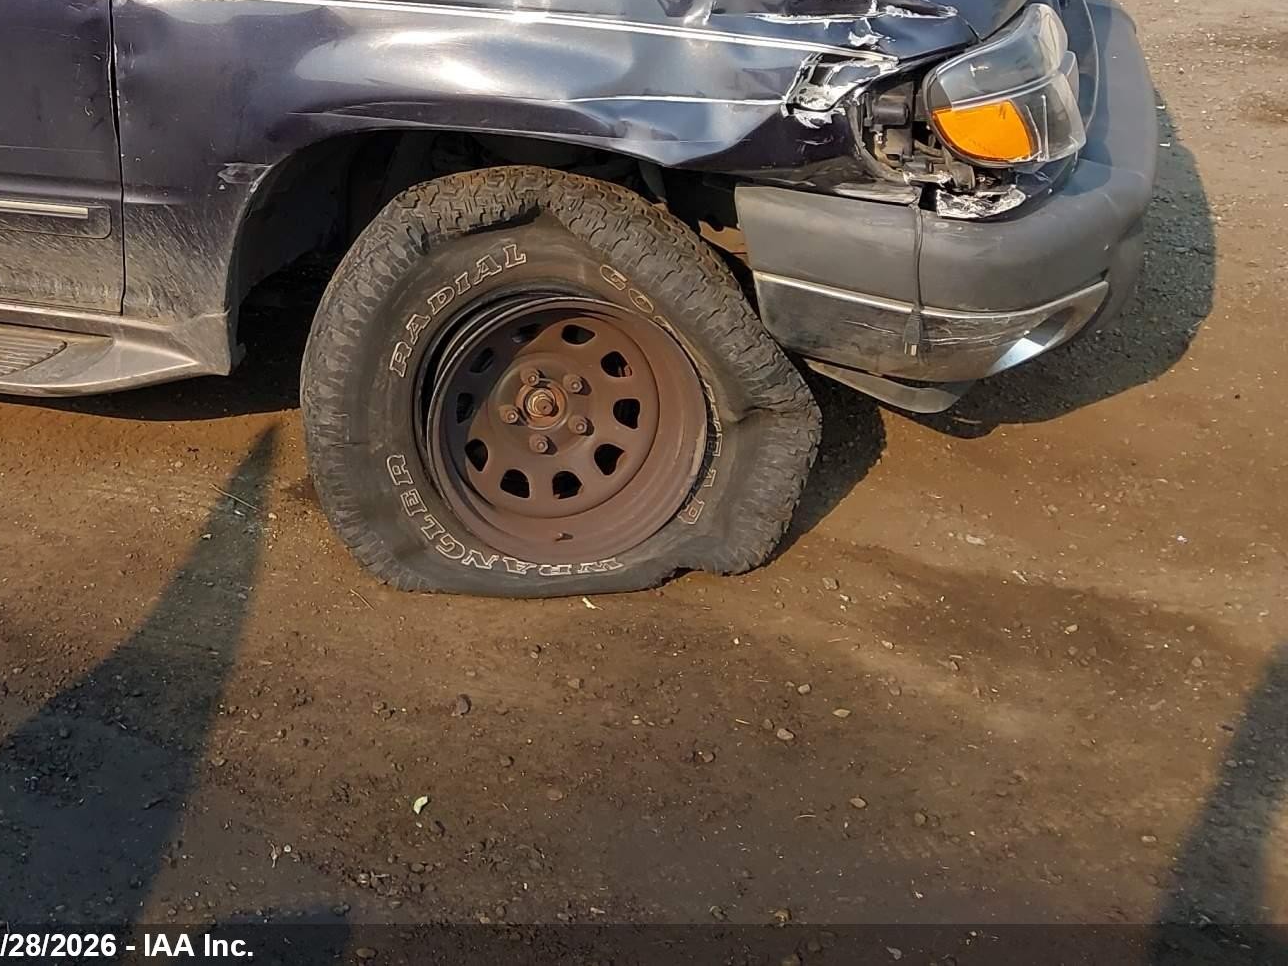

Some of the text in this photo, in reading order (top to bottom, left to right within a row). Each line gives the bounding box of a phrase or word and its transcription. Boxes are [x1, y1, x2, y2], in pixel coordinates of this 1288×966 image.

[389, 243, 527, 378] RADIAL
[600, 263, 723, 526] GOEAR
[386, 453, 625, 577] WRANGLER
